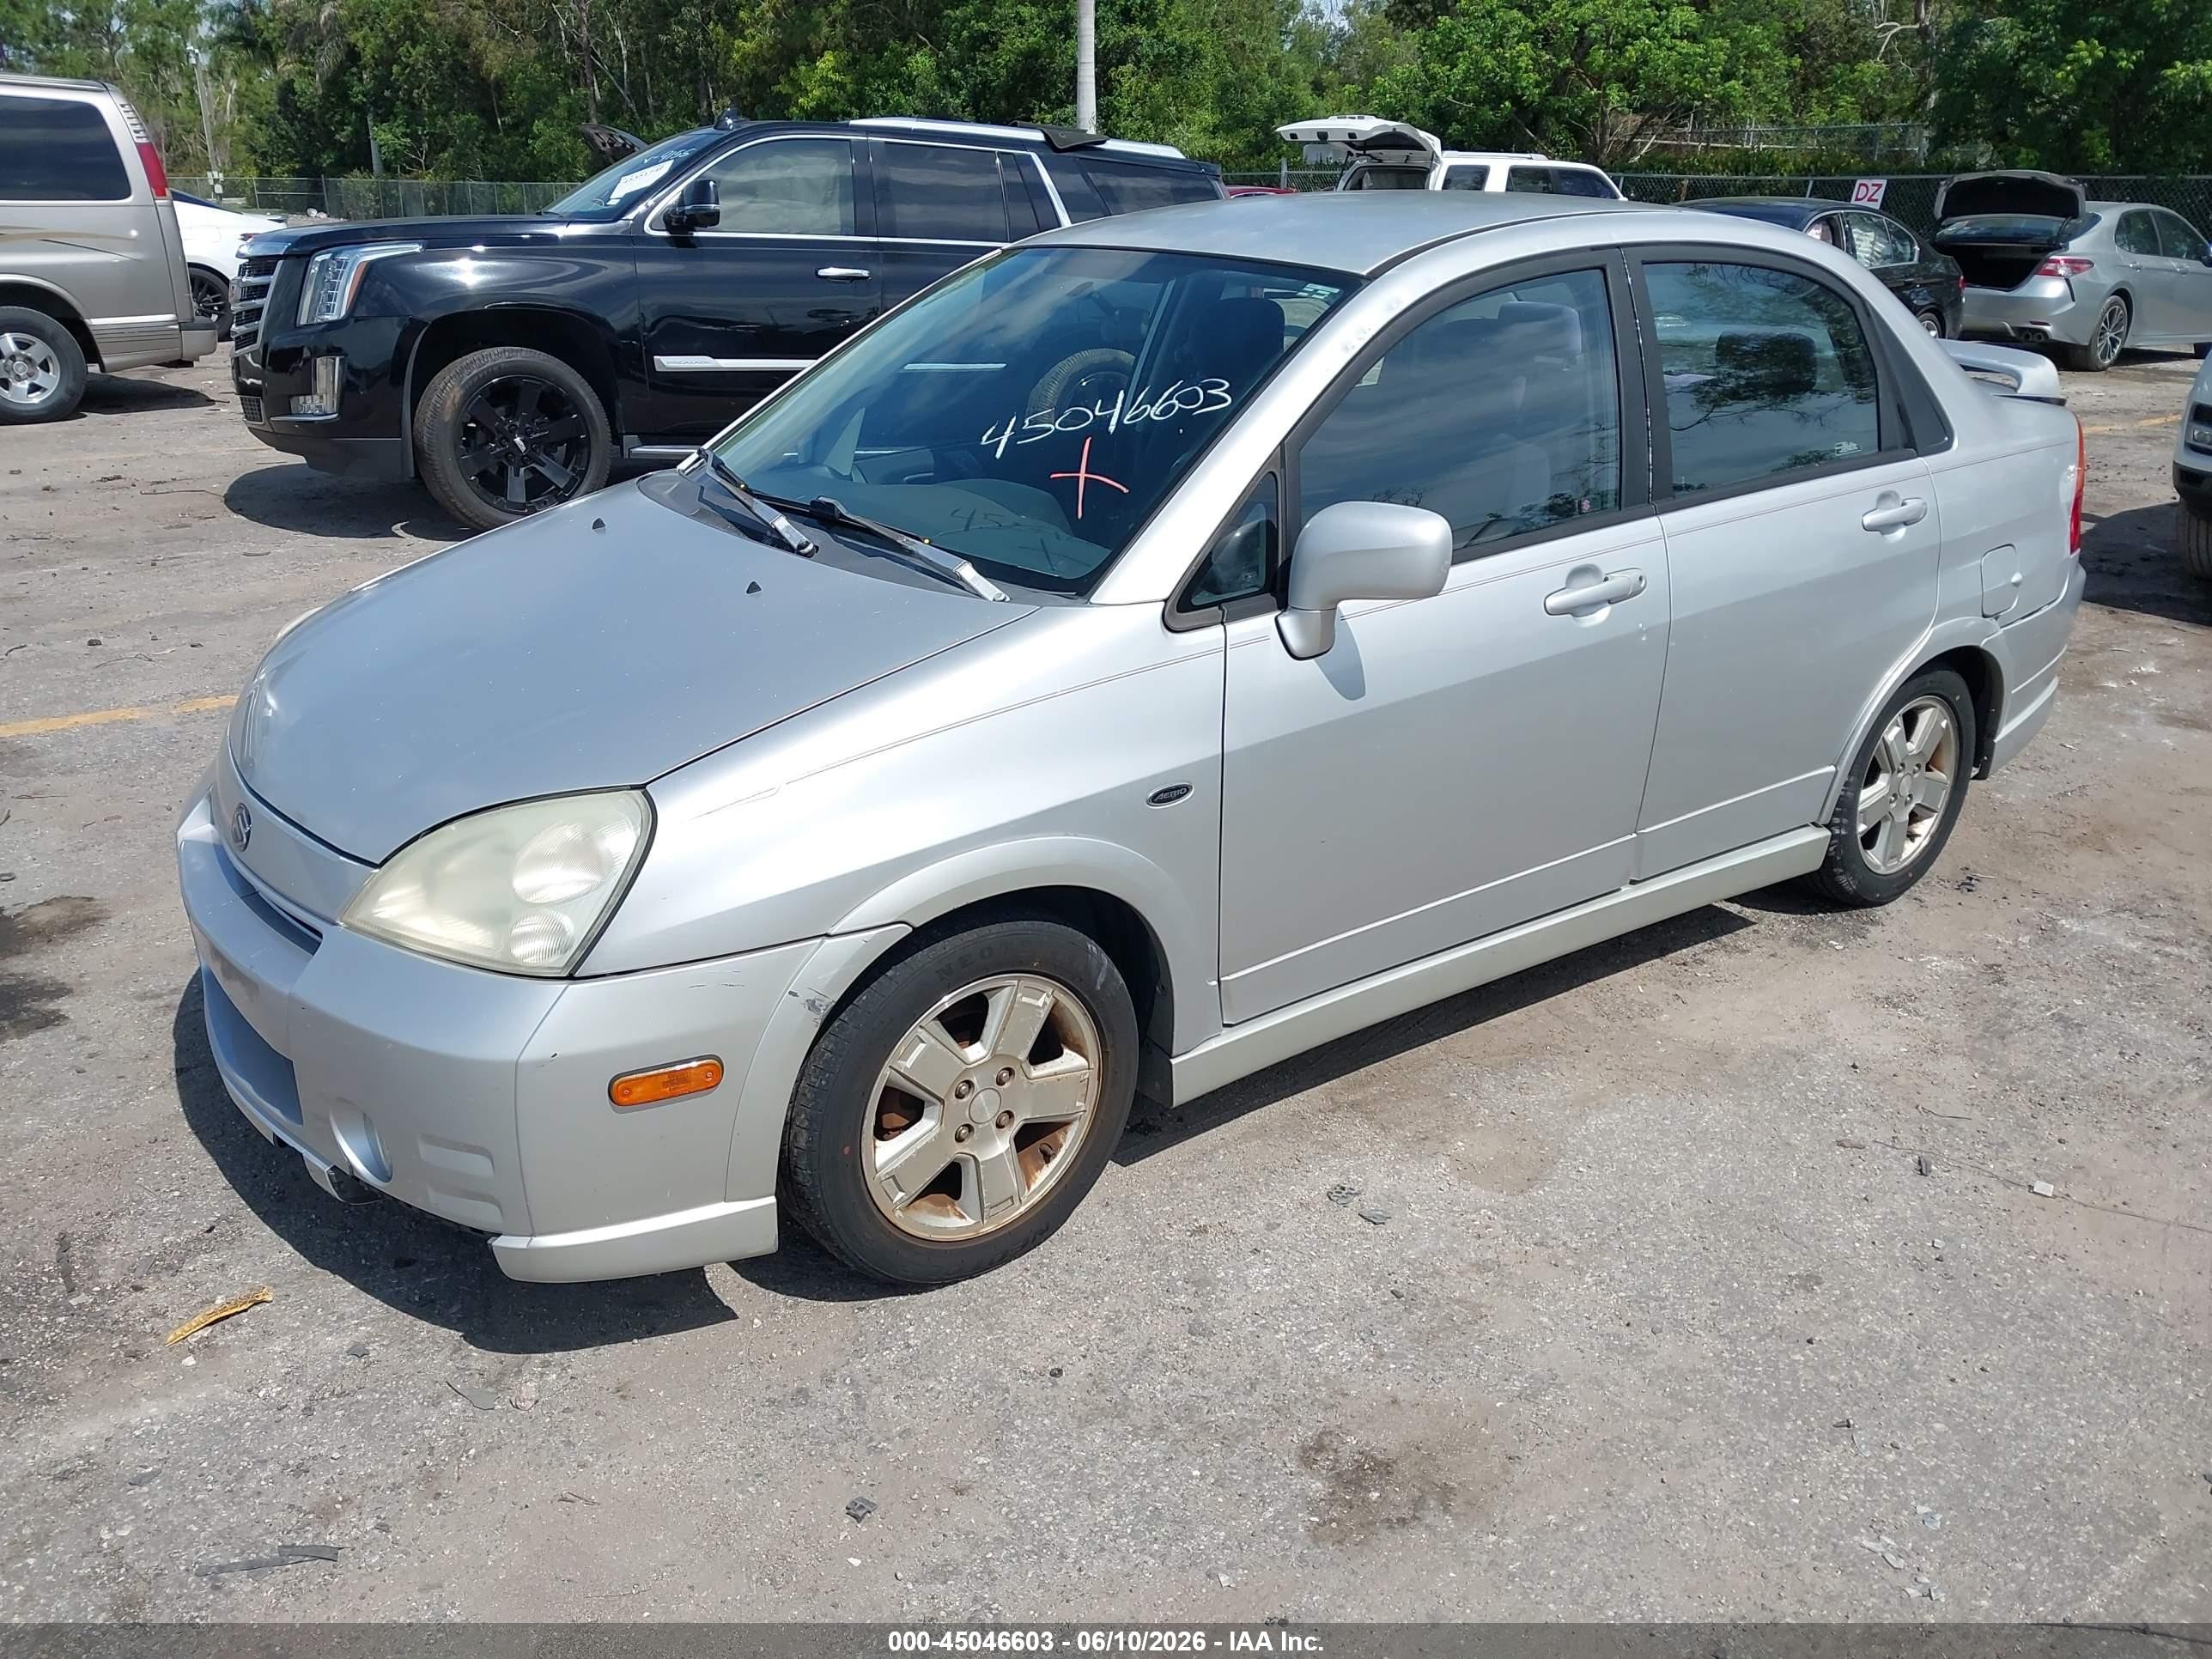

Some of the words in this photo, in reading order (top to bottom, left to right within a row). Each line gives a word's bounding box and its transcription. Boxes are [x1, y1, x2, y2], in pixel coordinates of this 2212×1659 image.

[1854, 182, 1883, 203] DZ
[981, 378, 1232, 459] 45046603
[1153, 787, 1187, 802] AERIO
